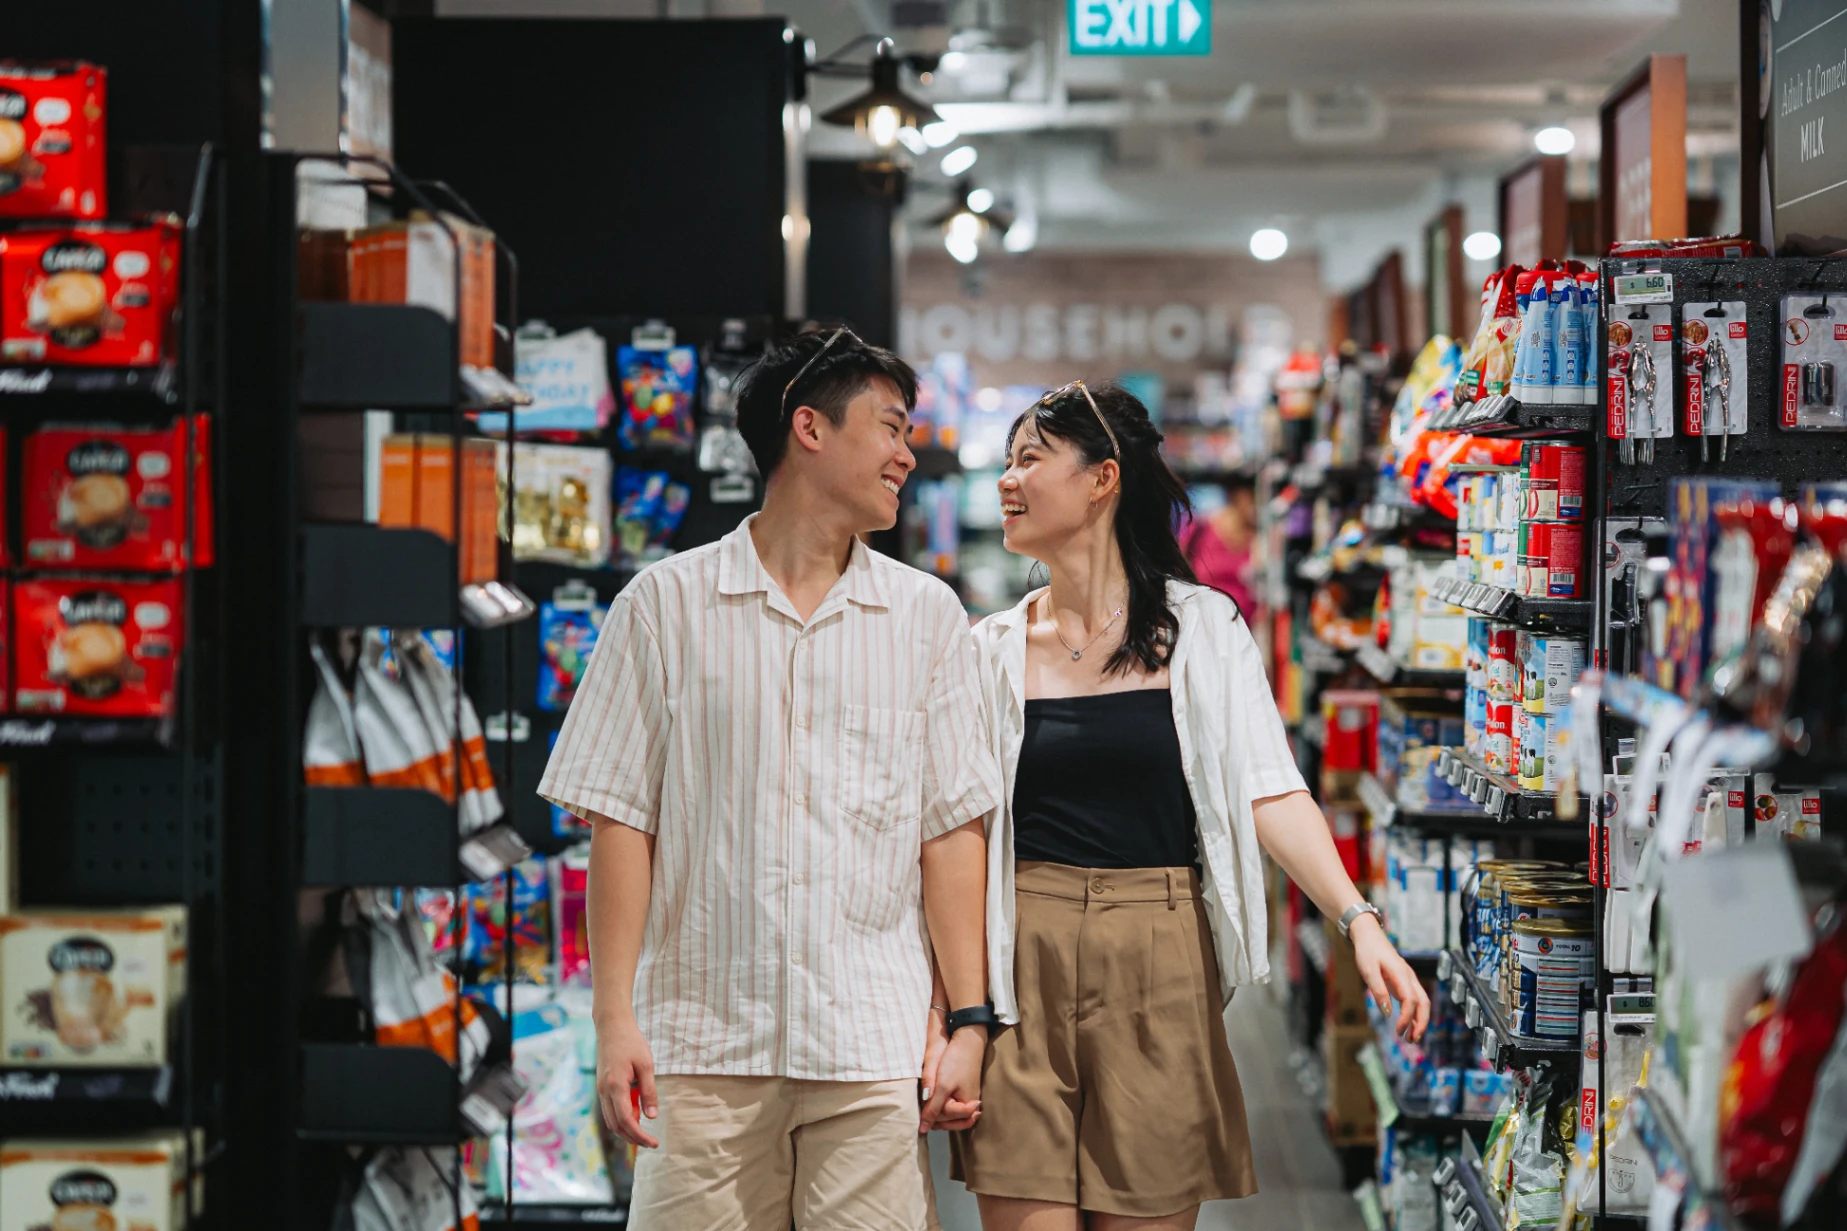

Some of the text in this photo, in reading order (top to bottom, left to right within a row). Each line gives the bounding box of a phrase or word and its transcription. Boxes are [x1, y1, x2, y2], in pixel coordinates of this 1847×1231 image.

[1075, 0, 1175, 47] EXIT
[1781, 48, 1847, 117] Adult & Canned
[1800, 116, 1824, 163] MILK
[1654, 326, 1669, 335] lillo
[1730, 323, 1744, 332] lillo
[1614, 380, 1624, 436] PEDRINI
[1690, 377, 1700, 433] PEDRINI
[1785, 366, 1797, 423] PEDRINI
[1729, 792, 1743, 802] lillo
[1803, 800, 1818, 809] lillo
[1583, 1091, 1595, 1136] EDRINI
[1610, 1154, 1638, 1167] PEDRINI
